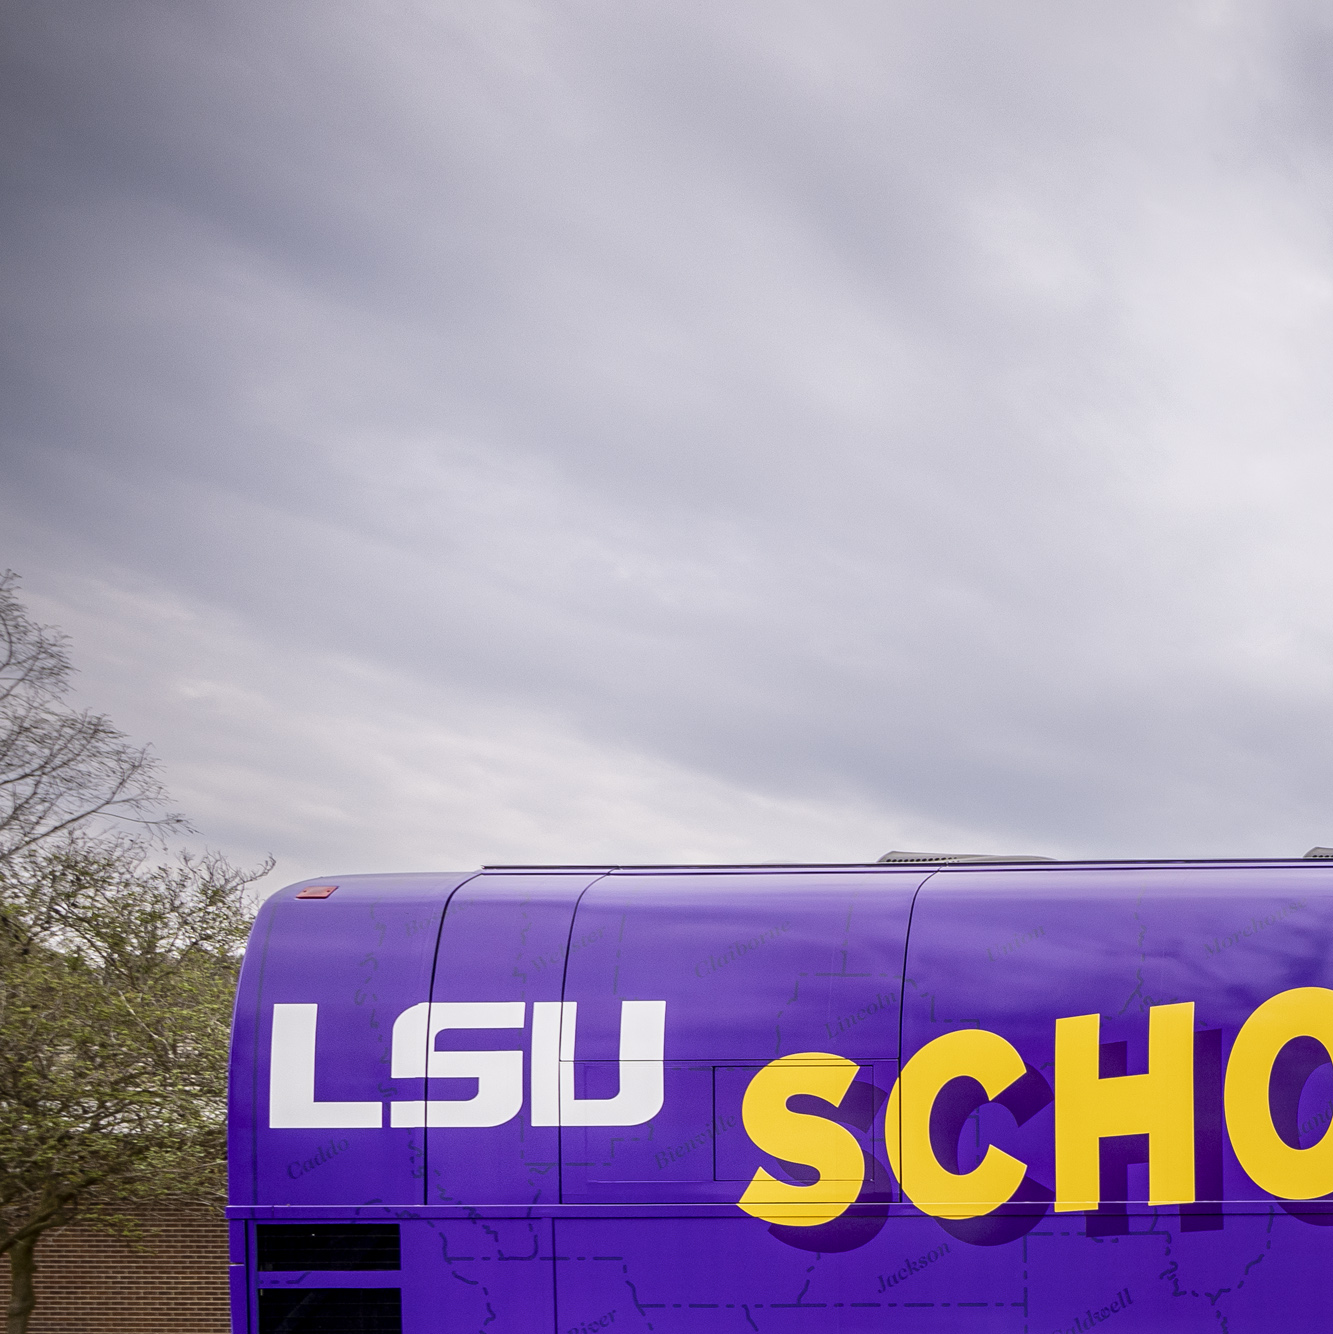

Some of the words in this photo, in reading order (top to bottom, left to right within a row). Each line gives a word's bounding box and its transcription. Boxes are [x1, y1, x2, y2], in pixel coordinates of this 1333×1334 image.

[694, 921, 793, 981] Claiborne
[824, 990, 898, 1041] Lincoln
[270, 1000, 666, 1128] LSU
[286, 1135, 350, 1180] Caddo
[653, 1111, 738, 1171] Bienville
[876, 1239, 951, 1295] Jackson
